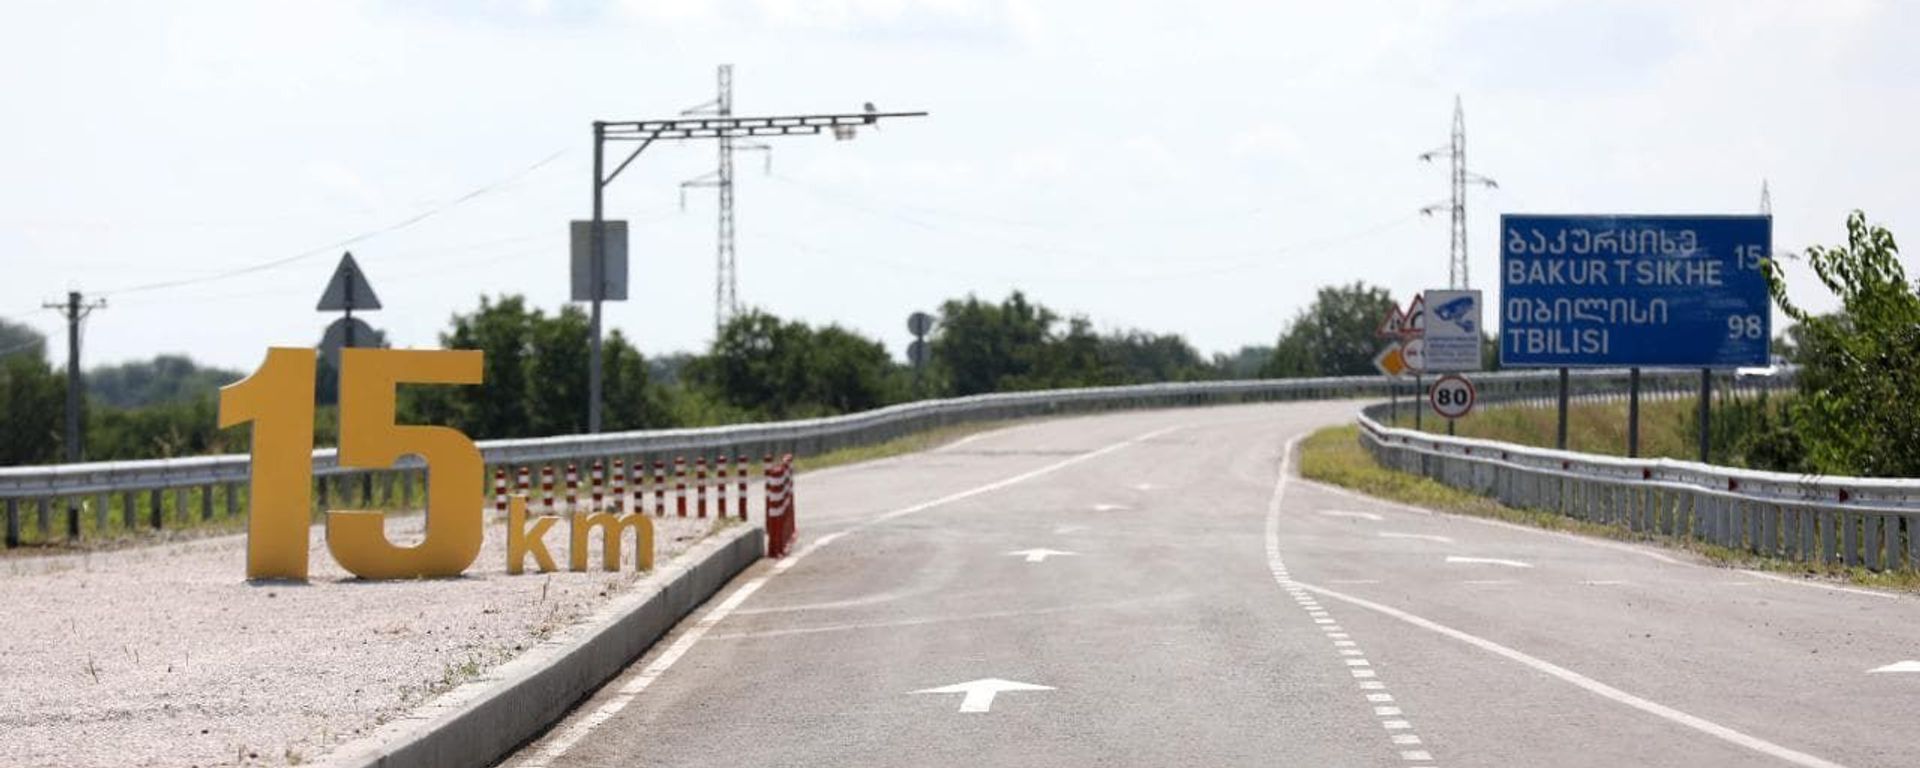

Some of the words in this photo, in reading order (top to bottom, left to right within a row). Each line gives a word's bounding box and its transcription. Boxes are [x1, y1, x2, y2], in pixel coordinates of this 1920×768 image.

[1734, 245, 1762, 270] 15
[1507, 298, 1668, 324] თბილისი
[1728, 315, 1762, 339] 98
[1508, 328, 1609, 354] TBILISI
[1438, 388, 1467, 406] 80
[218, 347, 484, 580] 15
[507, 494, 655, 575] km
